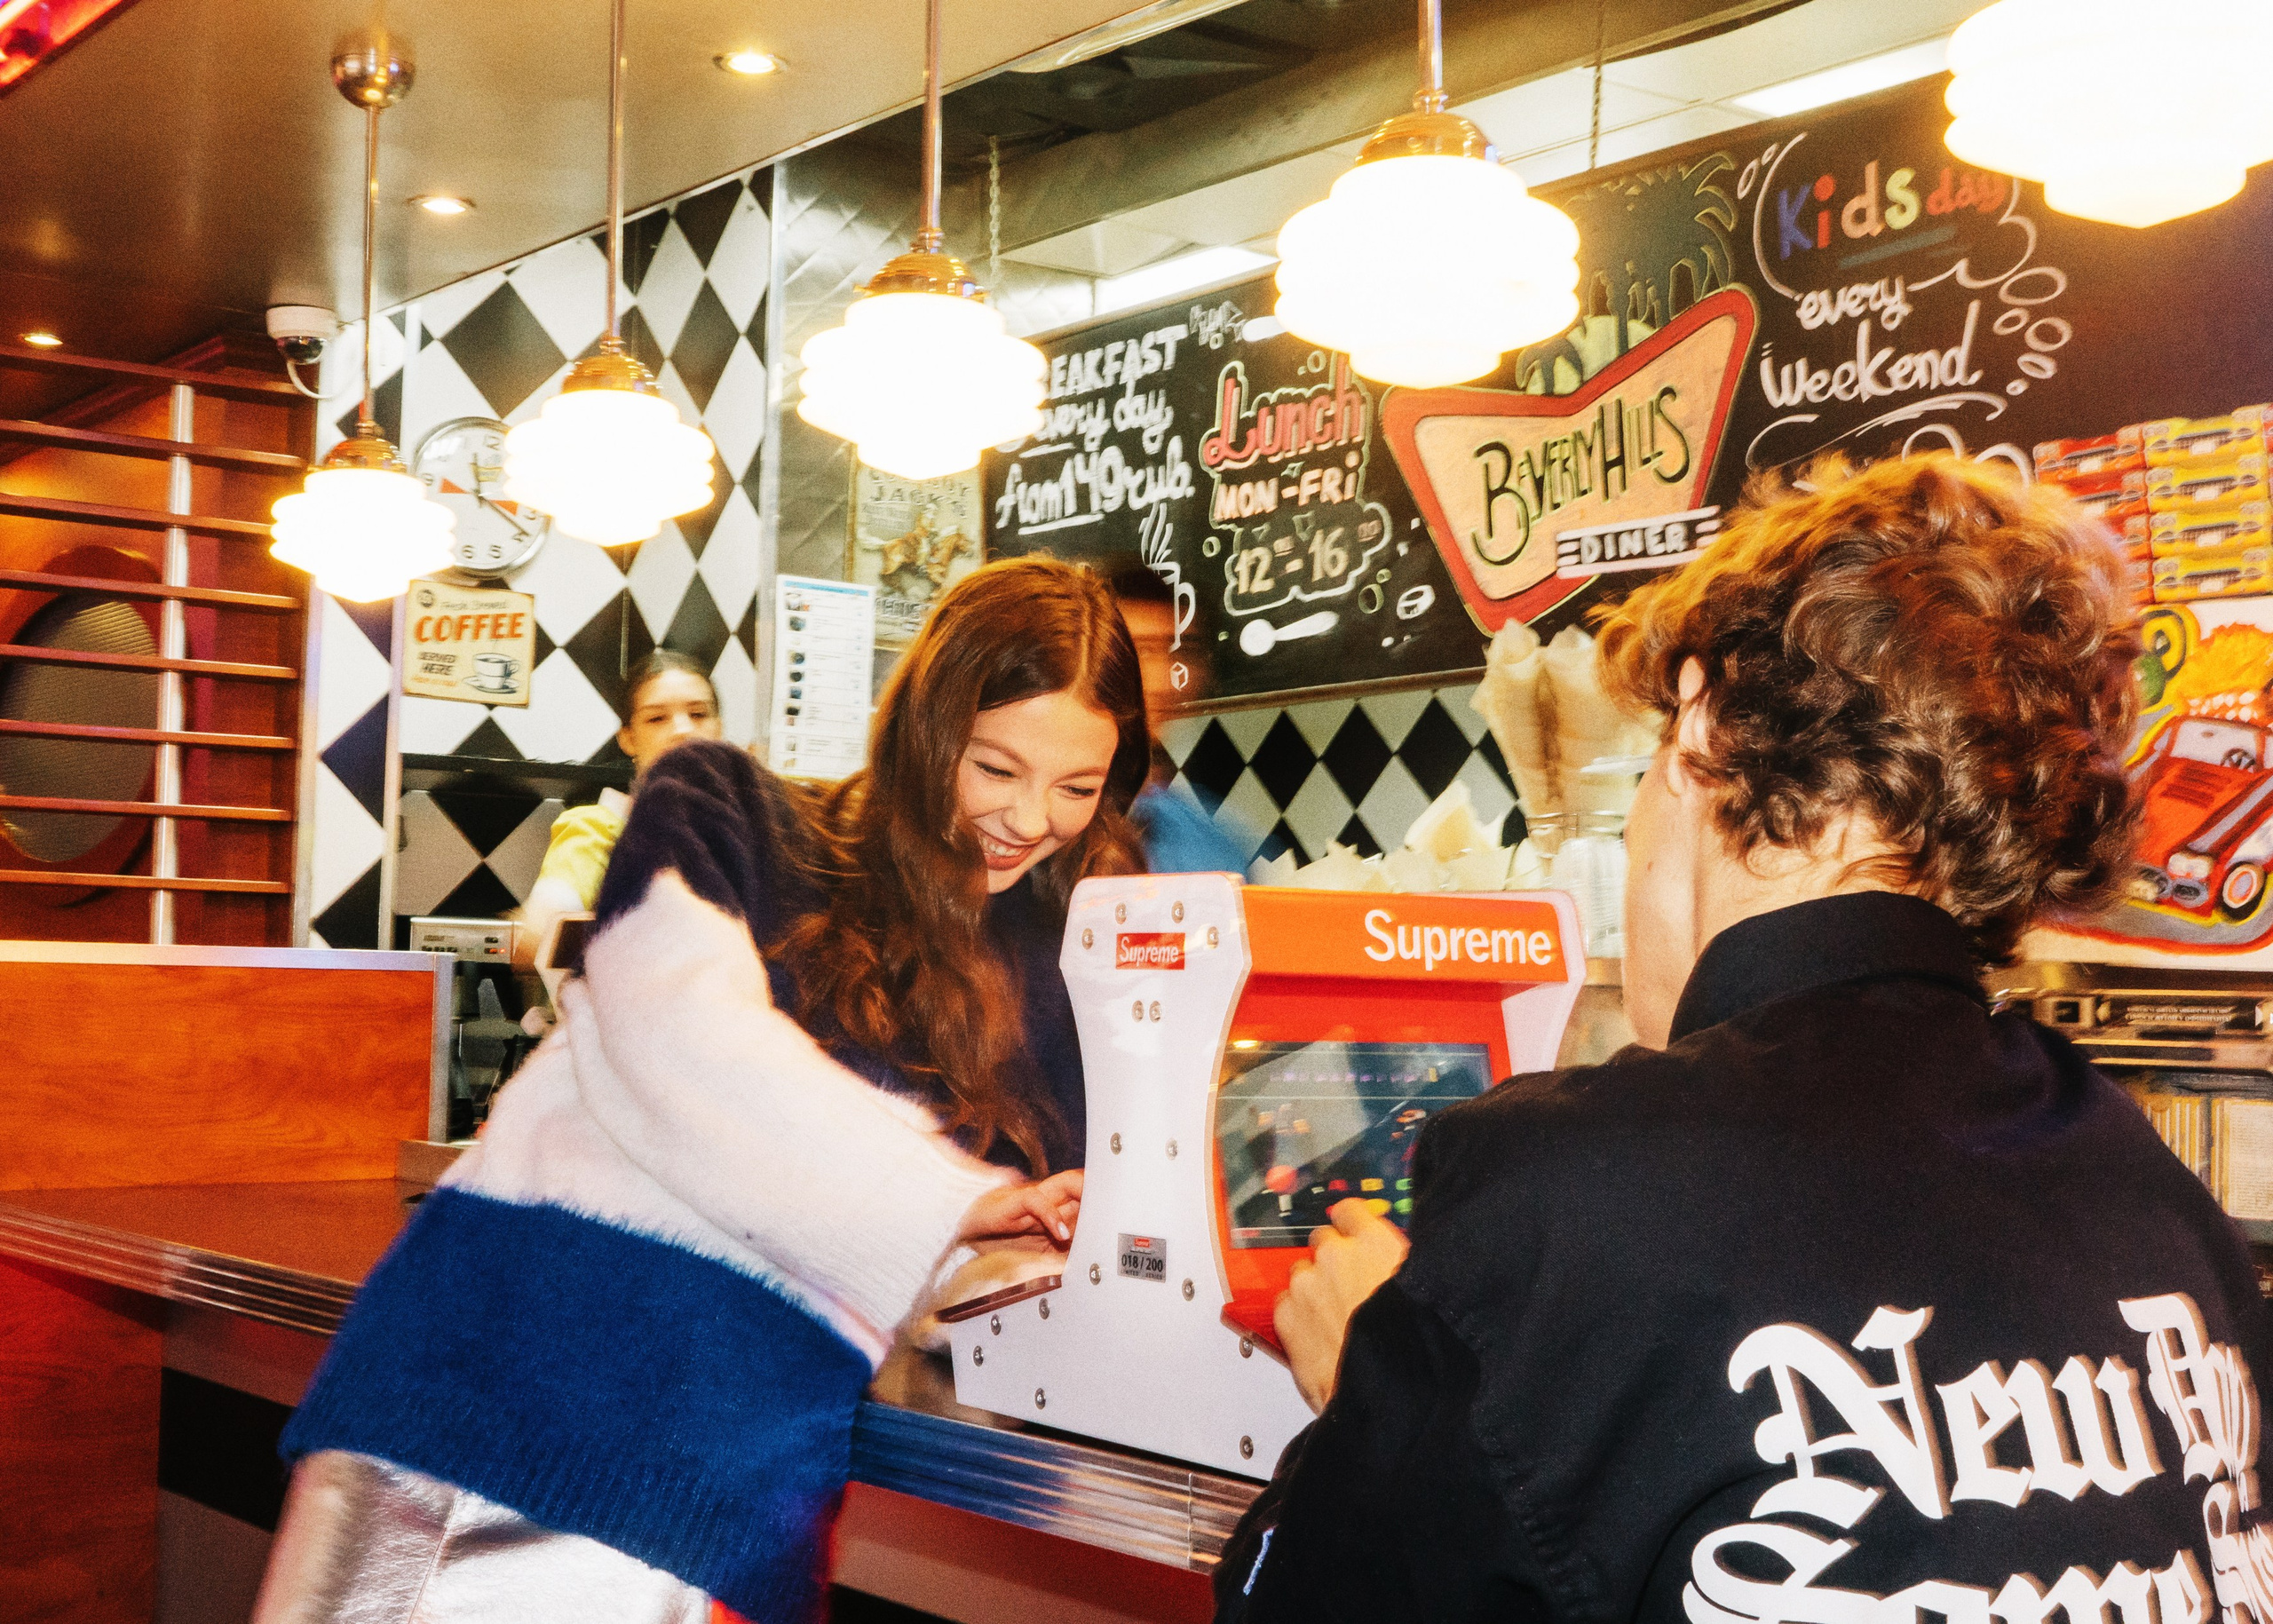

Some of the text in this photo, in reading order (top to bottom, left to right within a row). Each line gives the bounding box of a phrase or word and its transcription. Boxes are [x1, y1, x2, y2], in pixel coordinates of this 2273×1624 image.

[1777, 162, 2007, 260] Kids day
[1796, 277, 1912, 331] every
[1043, 324, 1189, 400] EAKFAST
[996, 376, 1175, 456] very day
[1202, 353, 1365, 466] Lunch
[1579, 522, 1690, 565] DINER
[413, 612, 526, 644] COFFEE
[1120, 935, 1179, 967] Supreme
[1364, 907, 1553, 972] Supreme
[1728, 1303, 2166, 1529] New
